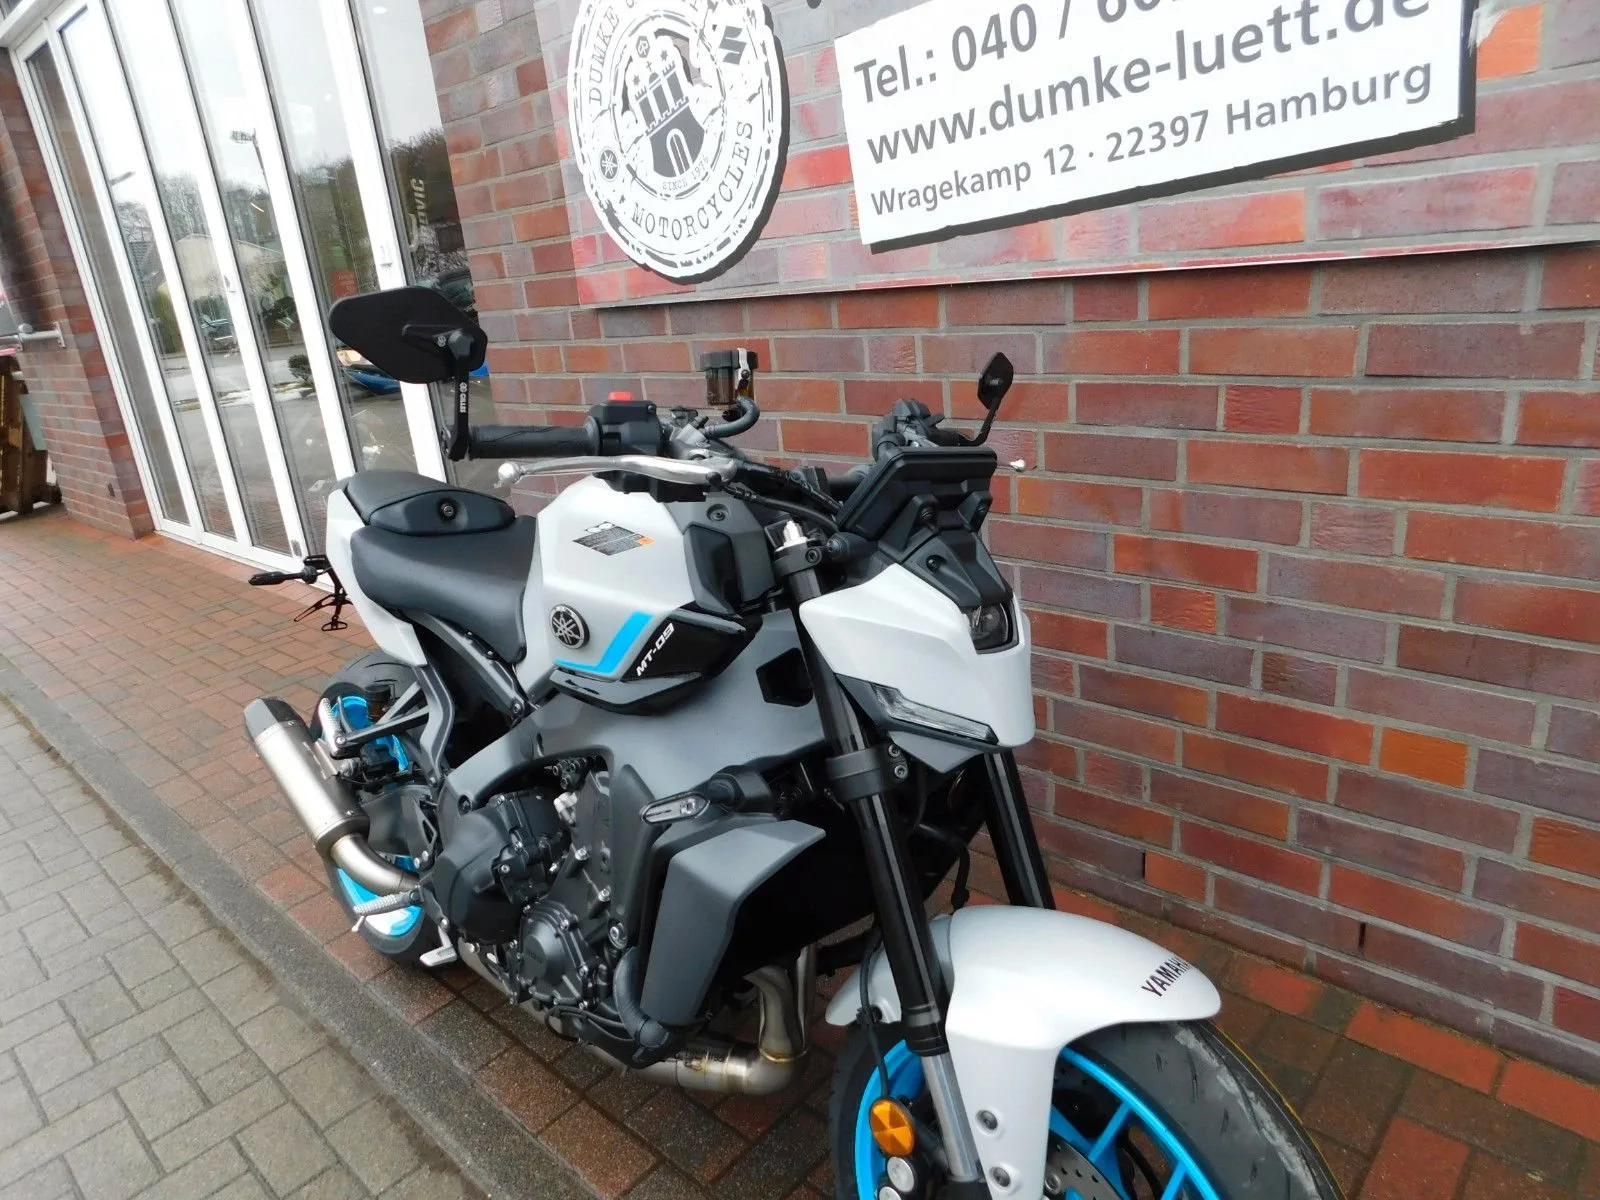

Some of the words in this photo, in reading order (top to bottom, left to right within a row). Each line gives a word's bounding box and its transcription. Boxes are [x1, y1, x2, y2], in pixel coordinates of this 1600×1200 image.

[588, 5, 620, 106] DUMKE
[853, 44, 937, 103] Tel.:
[951, 3, 1037, 72] 040
[631, 120, 753, 242] MOTORCYCLES
[870, 159, 1032, 216] Wragekamp
[1043, 143, 1077, 176] 12
[1106, 109, 1210, 163] 22397
[1226, 62, 1432, 136] Hamburg
[636, 622, 676, 677] MT-09
[1140, 956, 1191, 997] YAMAH
